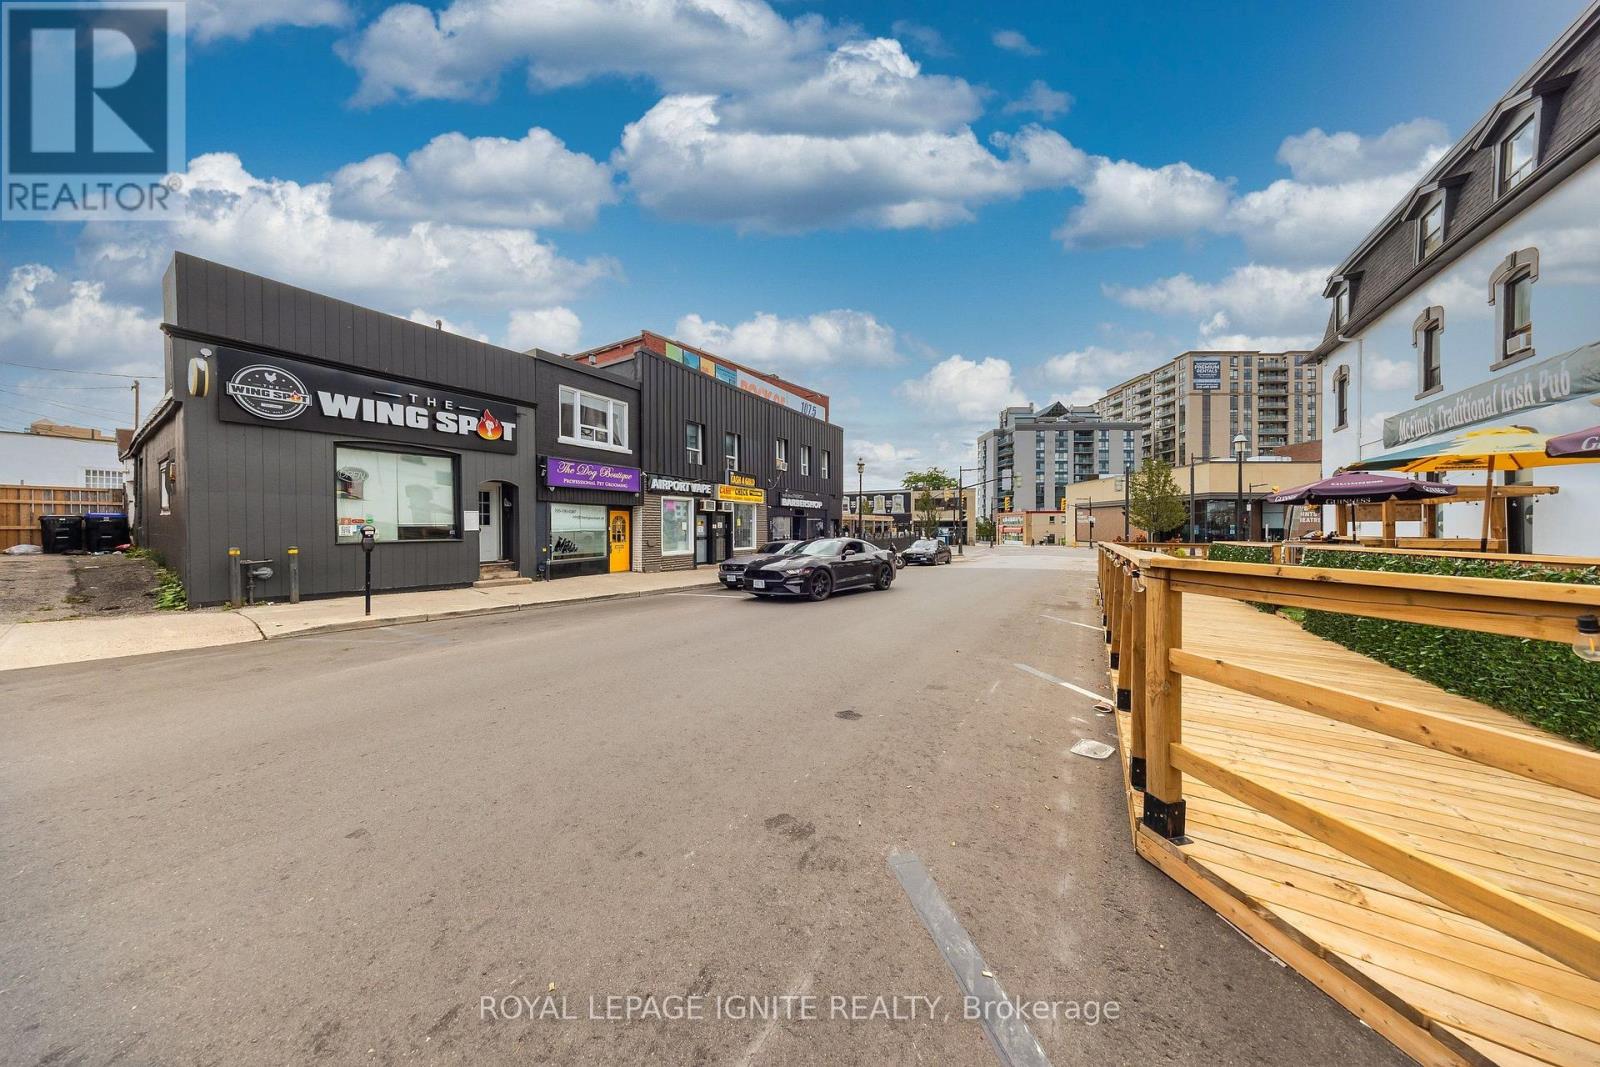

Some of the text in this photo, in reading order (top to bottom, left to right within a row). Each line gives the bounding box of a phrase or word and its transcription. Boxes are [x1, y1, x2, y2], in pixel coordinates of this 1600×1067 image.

[231, 384, 270, 398] WING
[1437, 386, 1499, 430] Traditional
[1501, 373, 1536, 414] Irish
[1539, 360, 1571, 403] Pub
[317, 390, 429, 430] WING
[409, 393, 454, 410] THE
[557, 461, 633, 482] The Dog Boutique
[651, 478, 711, 494] AIRPORT VAPE
